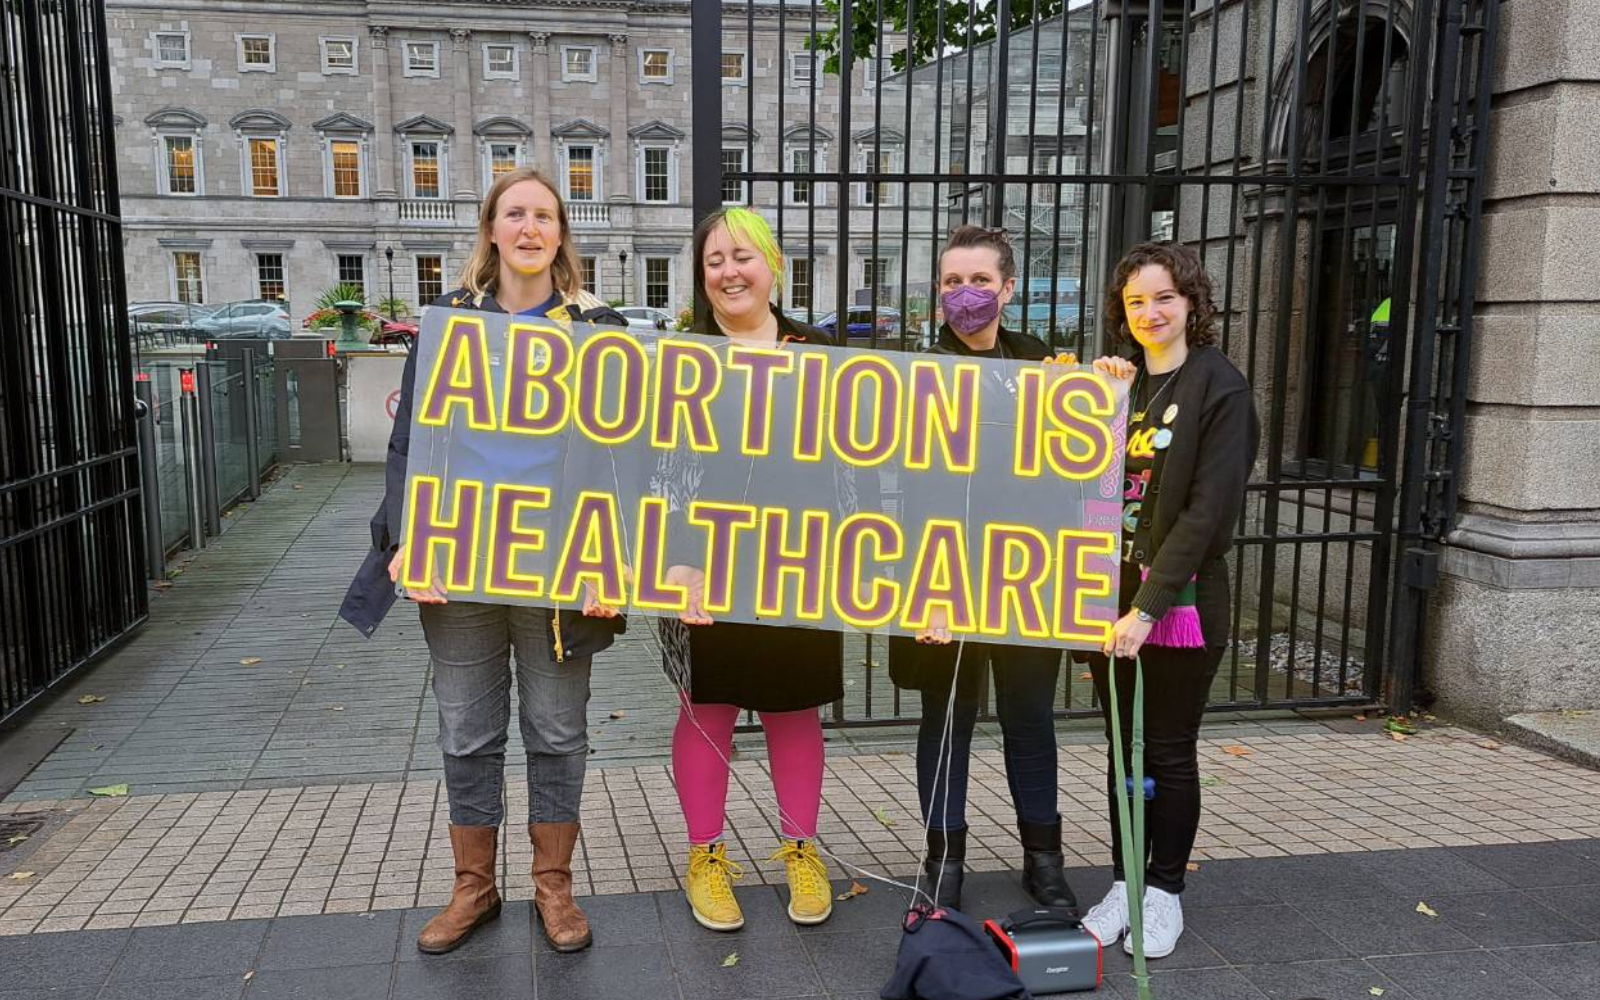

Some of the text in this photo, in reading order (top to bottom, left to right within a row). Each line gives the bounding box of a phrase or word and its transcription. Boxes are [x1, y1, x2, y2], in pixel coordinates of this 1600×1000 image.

[418, 315, 1116, 480] ABORTION IS
[402, 475, 1116, 642] HEALTHCARE
